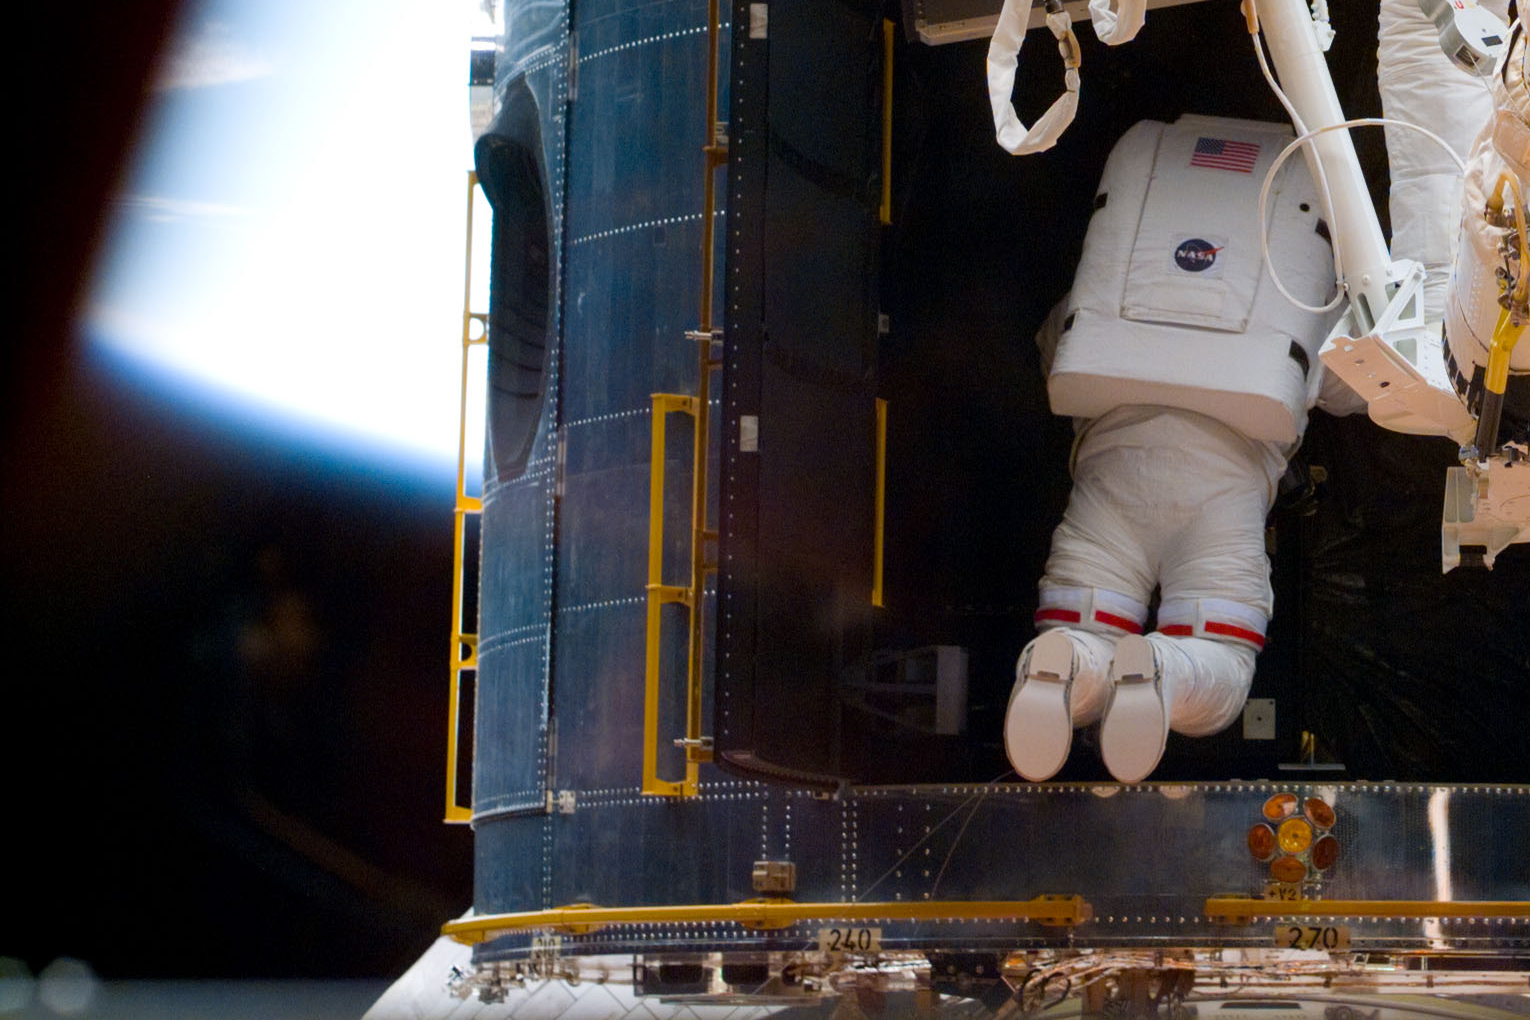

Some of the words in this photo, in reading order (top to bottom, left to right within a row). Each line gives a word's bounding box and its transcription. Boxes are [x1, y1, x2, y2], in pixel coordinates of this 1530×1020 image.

[1177, 249, 1214, 261] NASA
[830, 928, 871, 951] 240
[1289, 926, 1338, 949] 270
